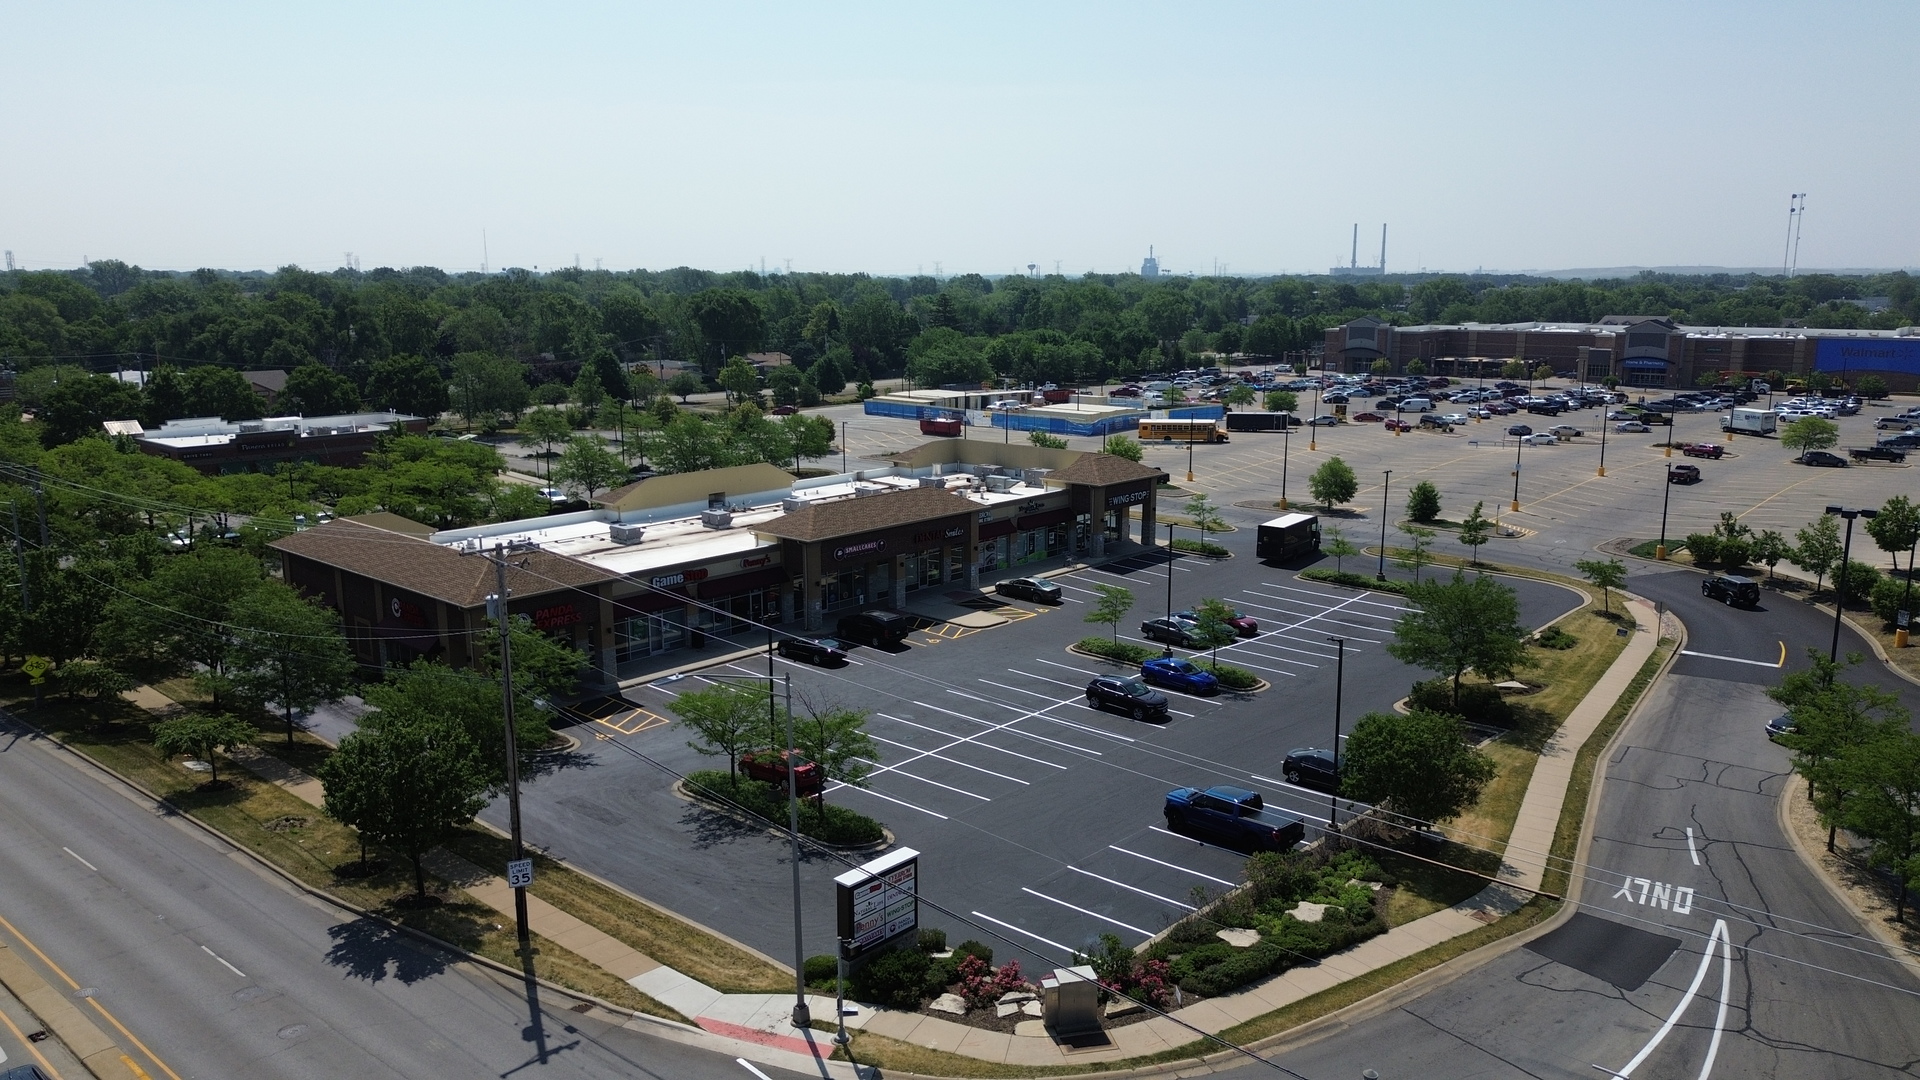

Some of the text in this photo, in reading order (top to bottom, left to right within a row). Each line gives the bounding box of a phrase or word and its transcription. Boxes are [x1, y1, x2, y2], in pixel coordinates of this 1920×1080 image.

[1841, 347, 1897, 359] Walmart
[845, 541, 877, 554] SMALLCAKES
[652, 568, 708, 588] GameStop
[535, 604, 573, 620] PANDA
[537, 612, 582, 628] EXPRESS
[510, 861, 531, 869] SPEED
[512, 867, 528, 875] LIMIT
[511, 873, 530, 885] 35
[1612, 875, 1694, 915] ONLY
[855, 914, 884, 932] Penny's
